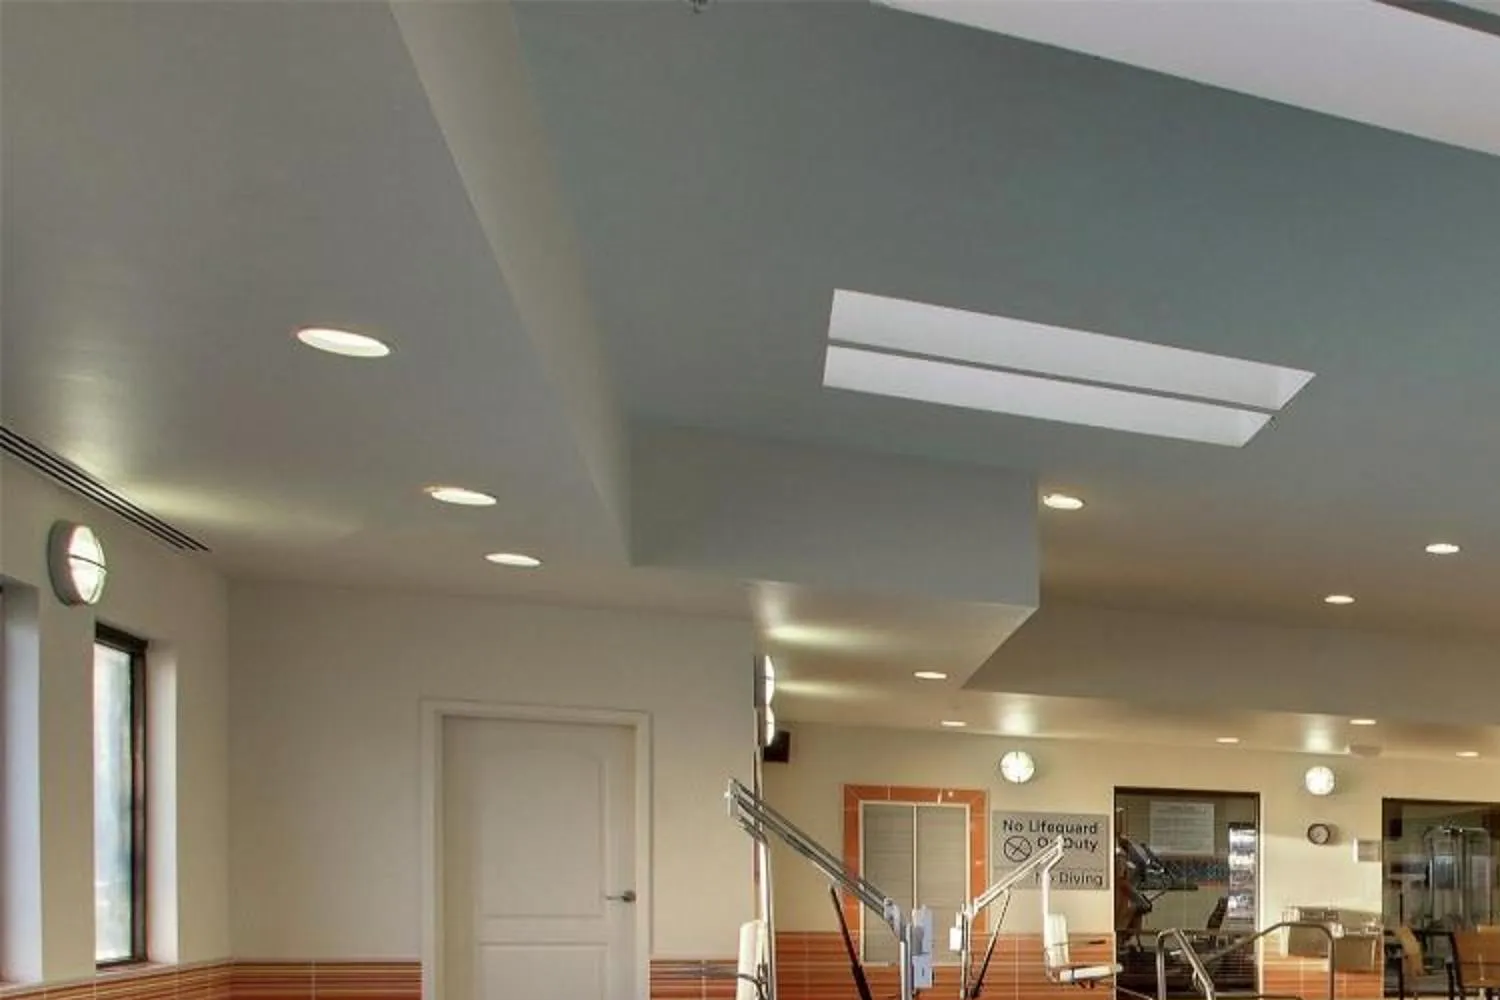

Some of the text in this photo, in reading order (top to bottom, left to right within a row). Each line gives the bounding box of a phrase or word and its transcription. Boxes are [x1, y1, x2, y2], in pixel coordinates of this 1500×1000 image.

[1003, 819, 1099, 836] No Lifeguard
[1062, 836, 1099, 853] Duty
[1059, 871, 1104, 886] Diving
